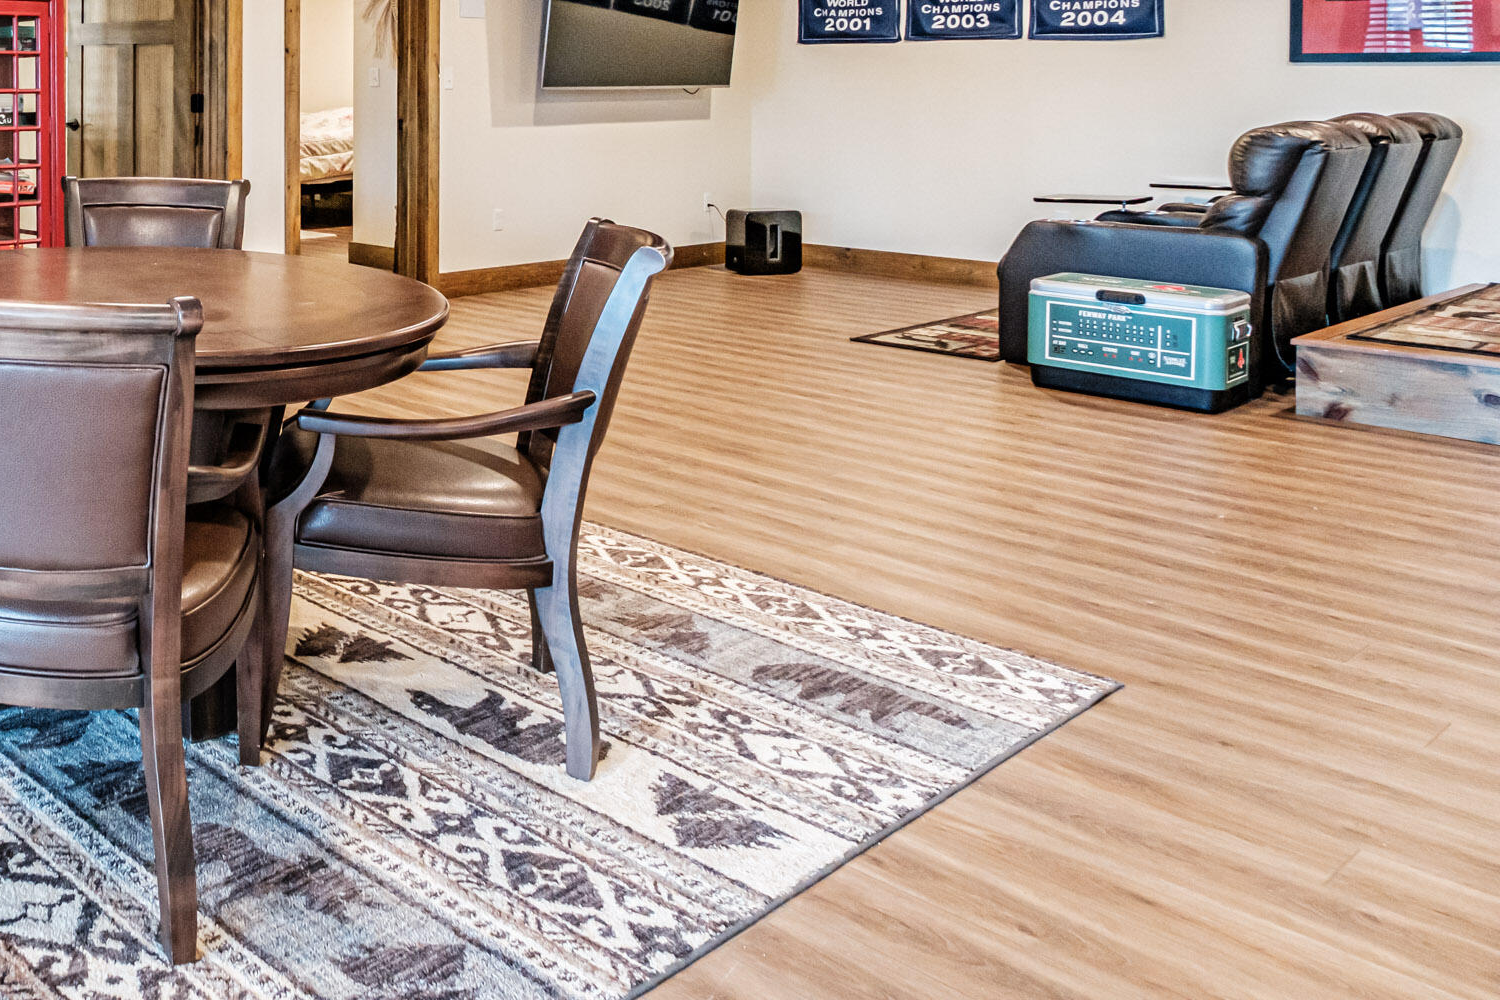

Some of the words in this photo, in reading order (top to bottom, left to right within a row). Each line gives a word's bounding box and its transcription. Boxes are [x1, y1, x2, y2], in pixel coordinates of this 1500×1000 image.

[813, 7, 883, 18] CHAMPIONS
[921, 2, 1000, 14] CHAMPIONS
[824, 17, 871, 31] 2001
[931, 13, 990, 29] 2003
[1059, 9, 1127, 26] 2004
